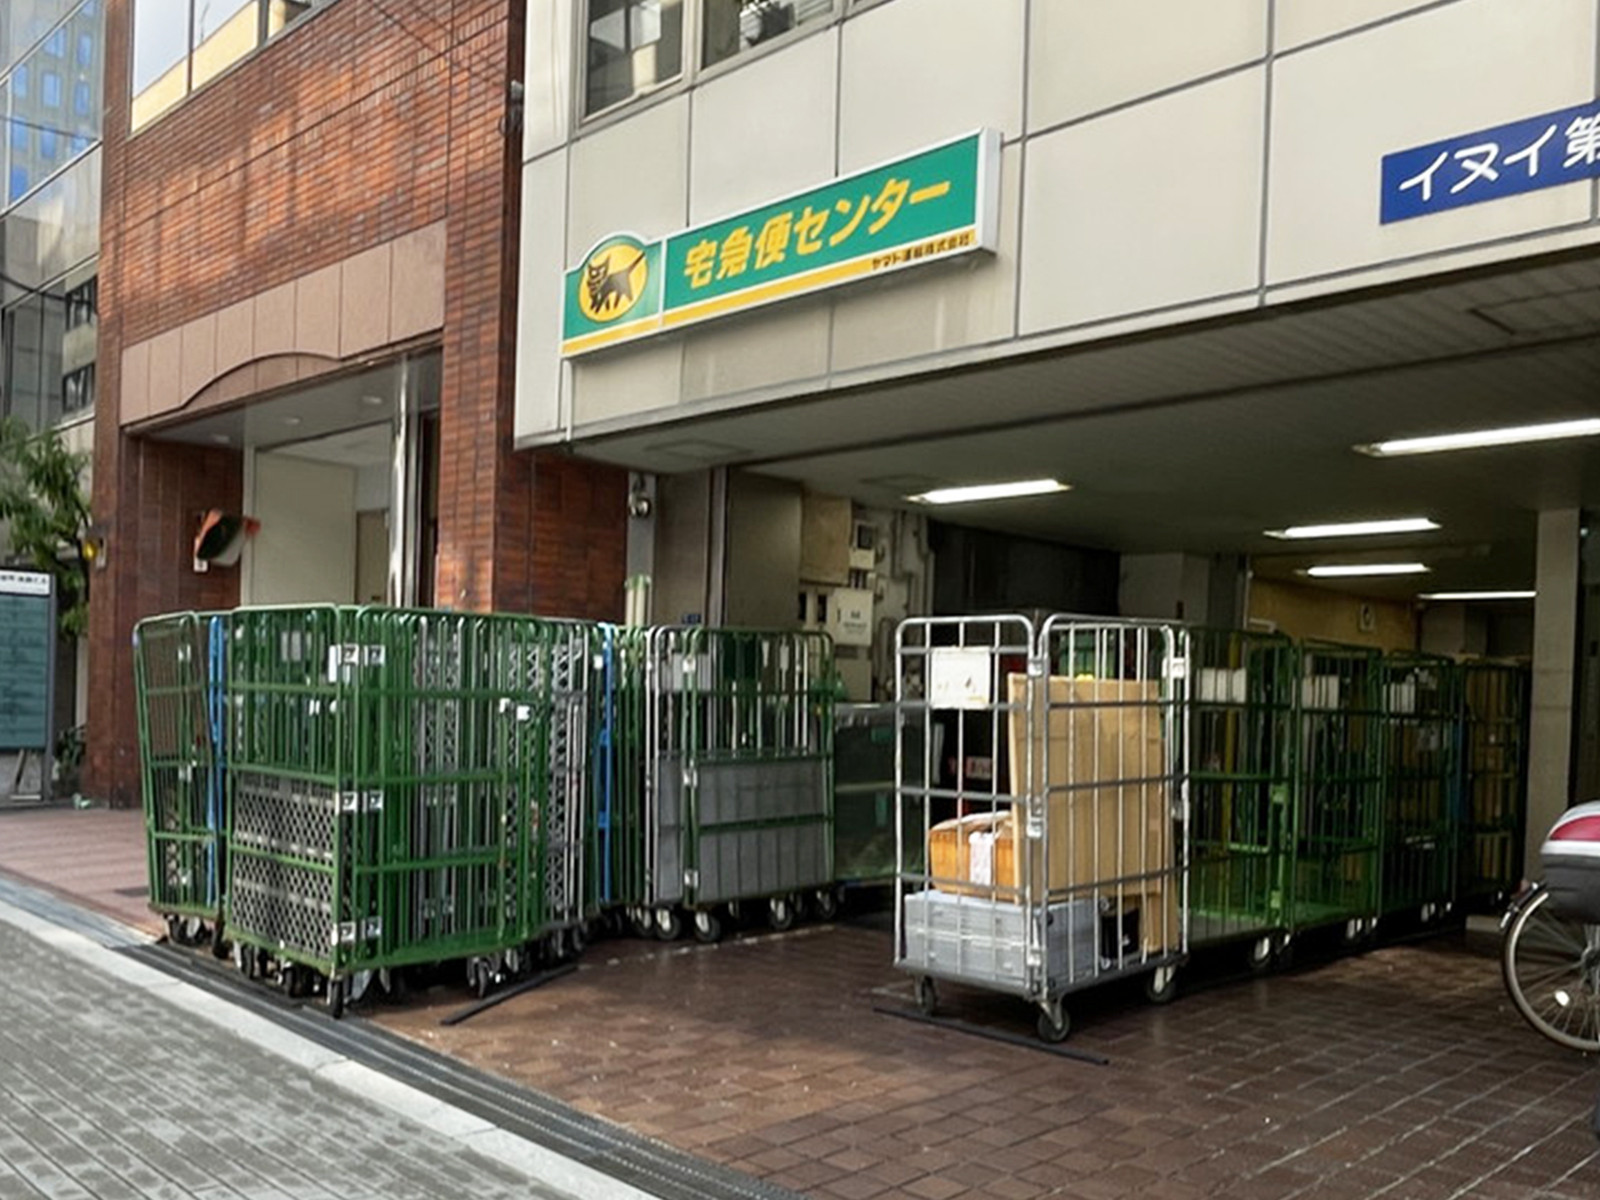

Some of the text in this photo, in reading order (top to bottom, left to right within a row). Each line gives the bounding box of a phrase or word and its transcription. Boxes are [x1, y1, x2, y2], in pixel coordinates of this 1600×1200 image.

[683, 176, 951, 290] 宅急便センター
